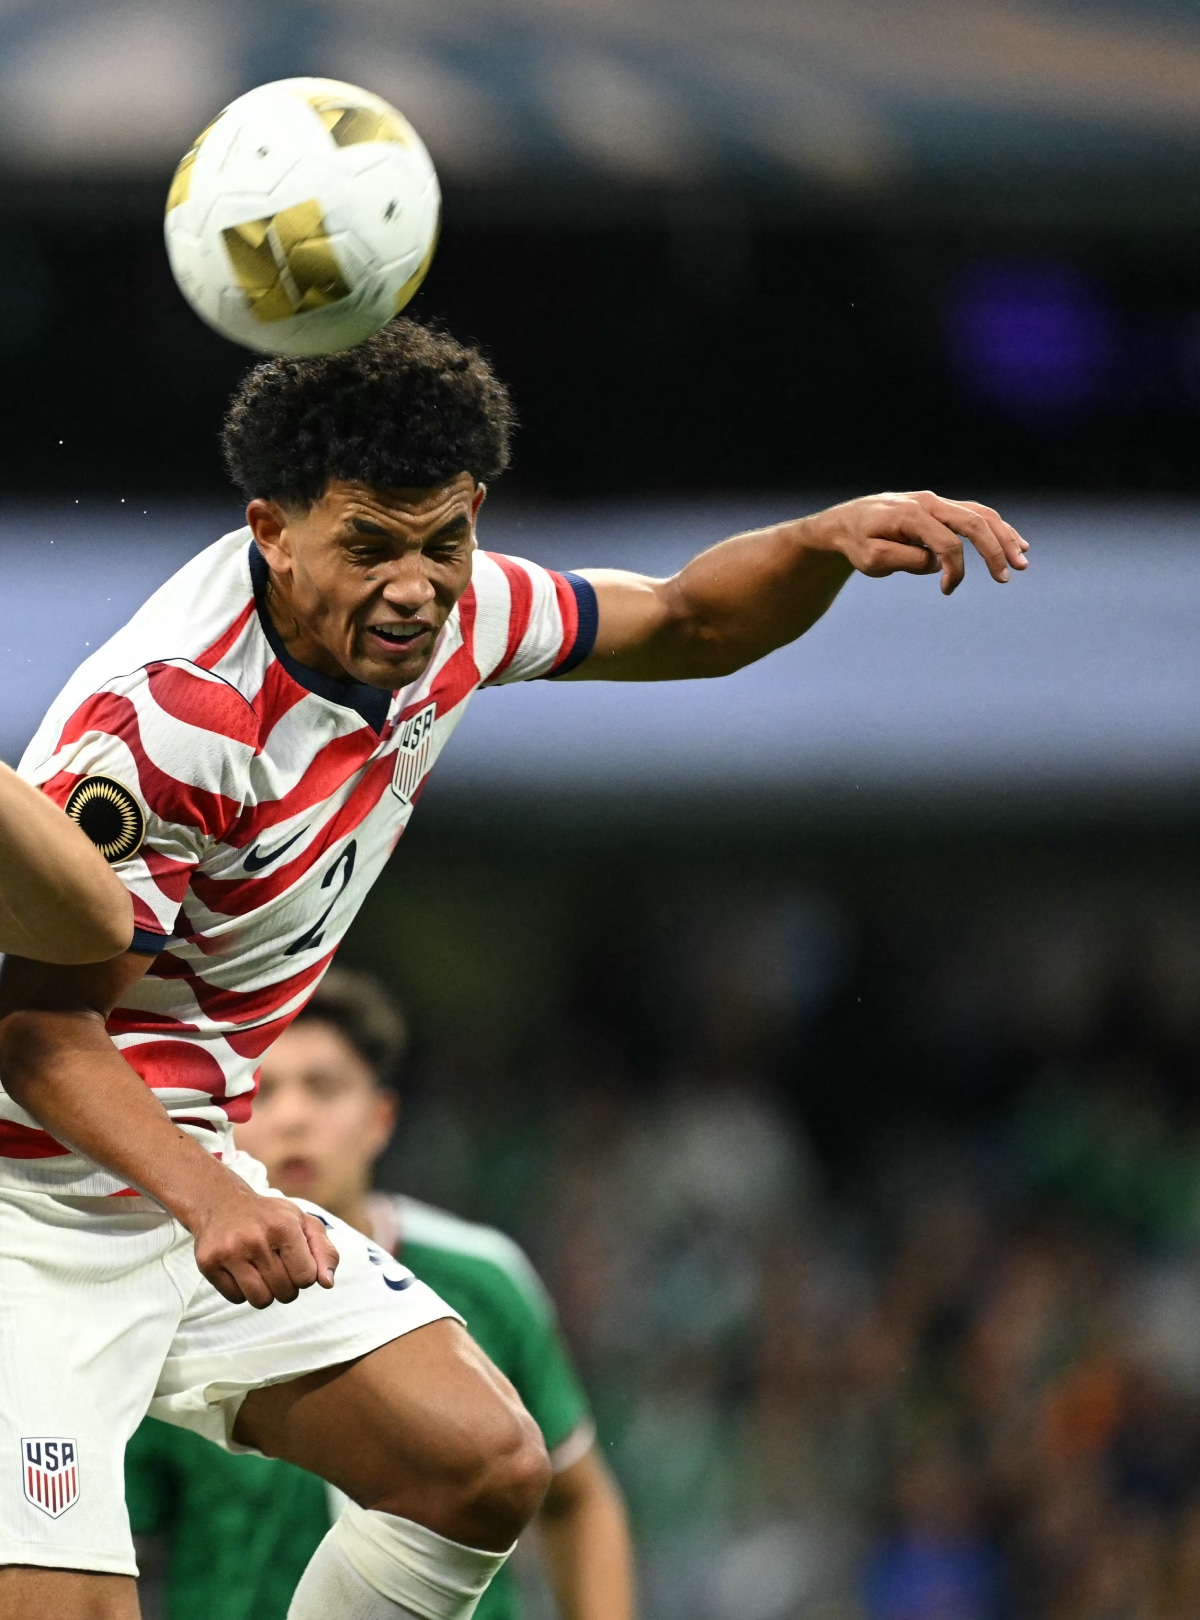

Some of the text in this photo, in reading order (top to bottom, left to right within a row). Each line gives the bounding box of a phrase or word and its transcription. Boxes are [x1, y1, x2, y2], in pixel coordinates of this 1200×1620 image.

[402, 709, 433, 750] USA
[283, 838, 357, 956] 2
[26, 1442, 74, 1472] USA
